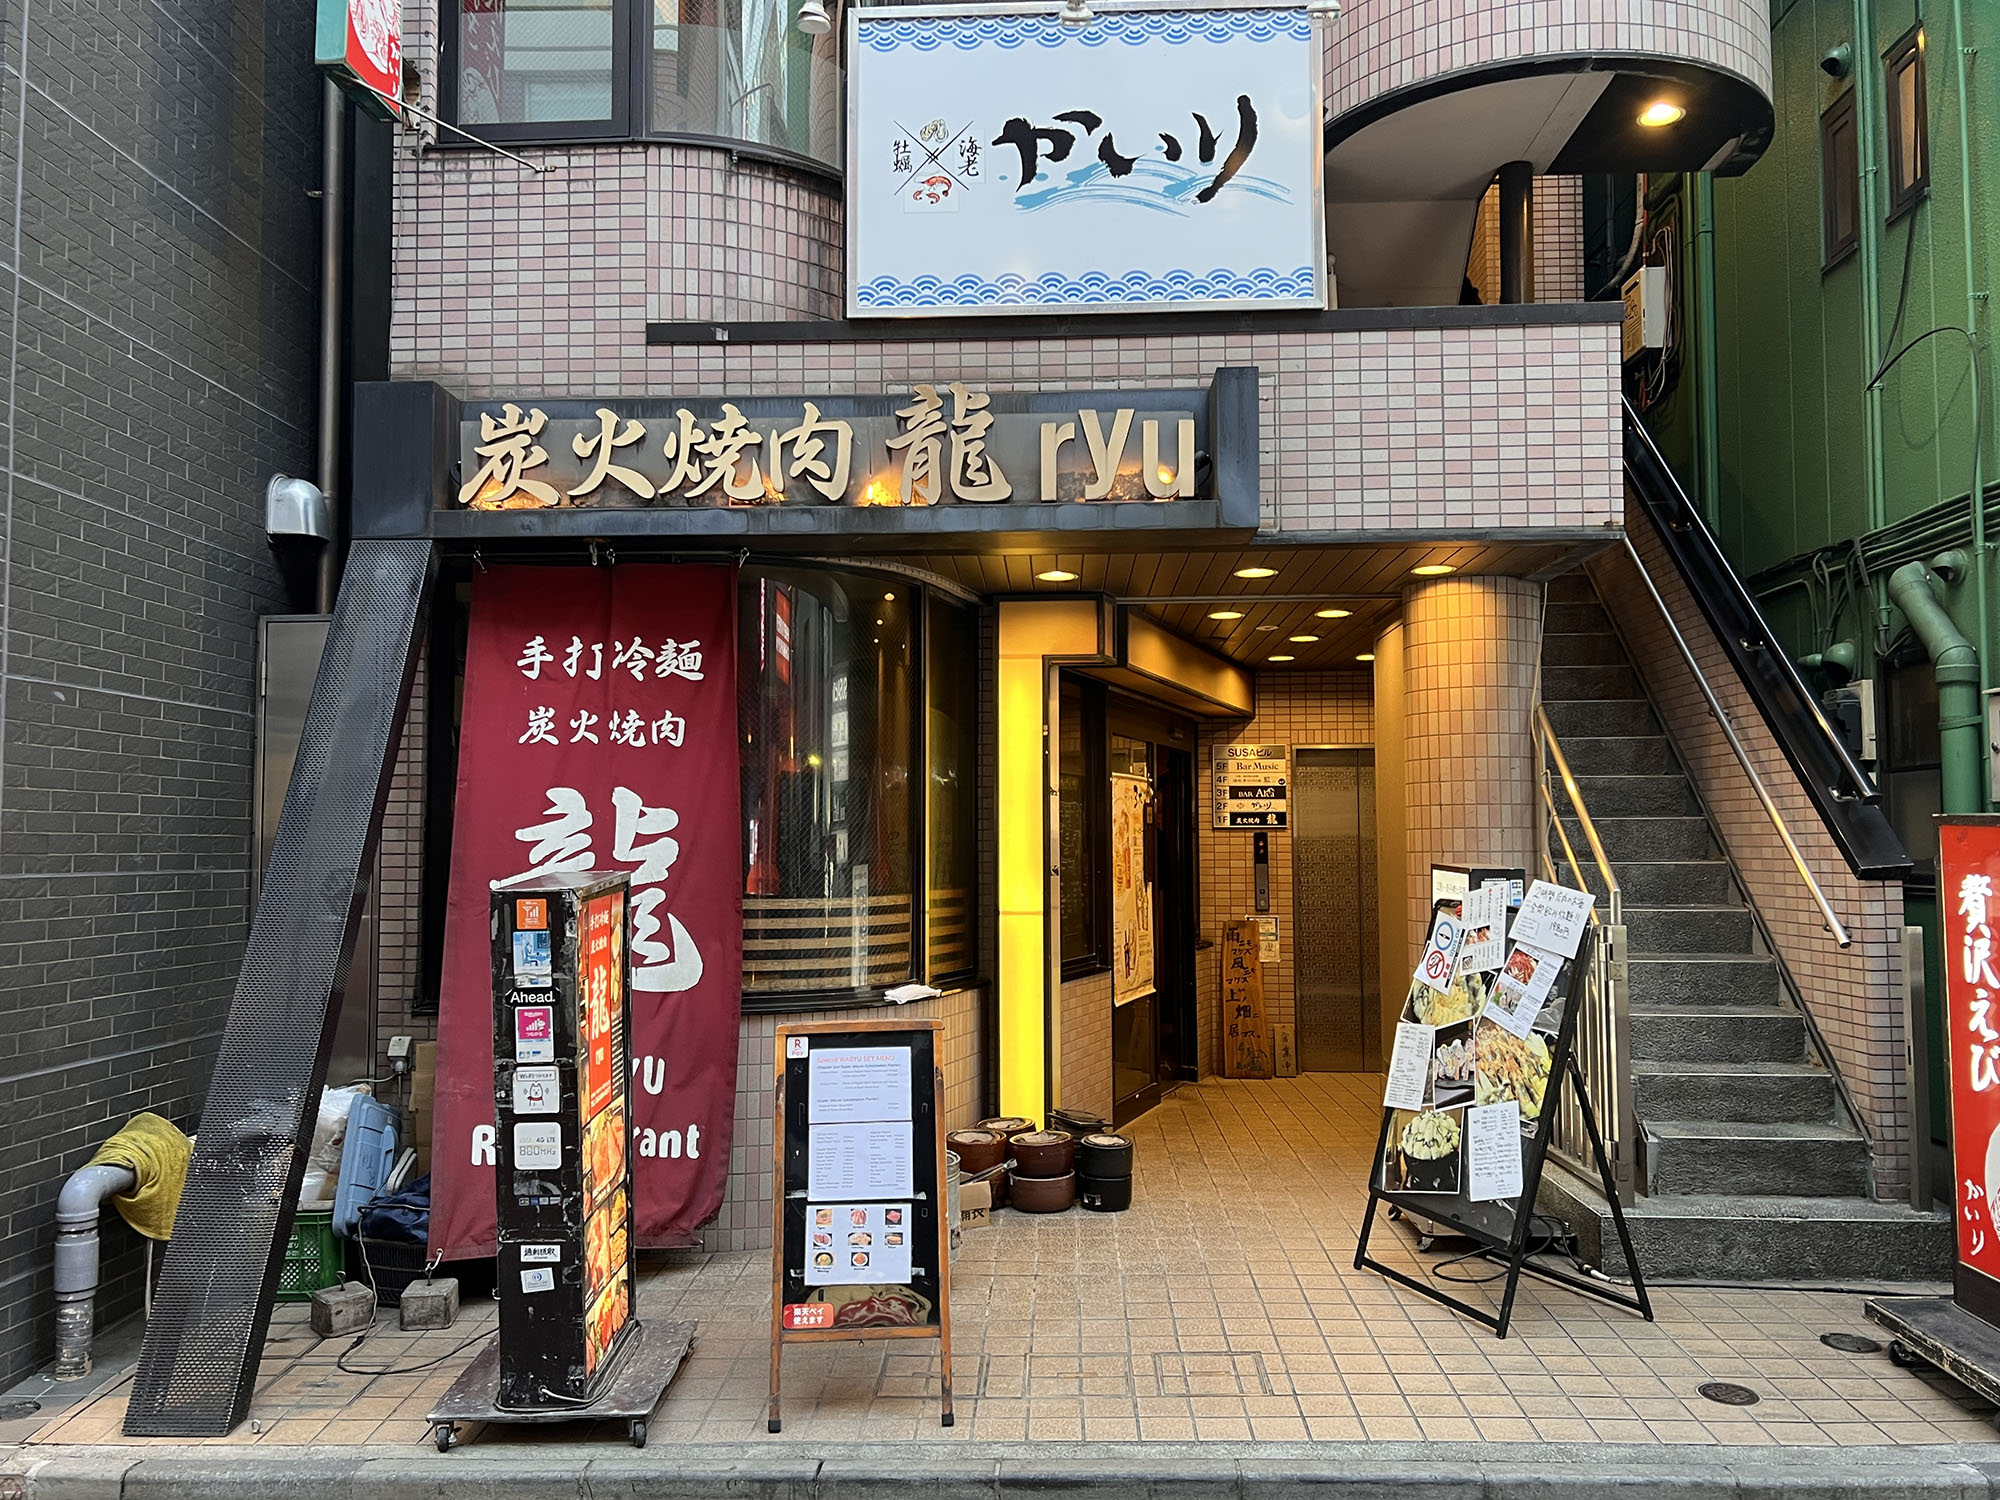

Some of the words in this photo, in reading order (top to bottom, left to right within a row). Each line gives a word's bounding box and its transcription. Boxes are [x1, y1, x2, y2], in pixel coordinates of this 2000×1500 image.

[893, 139, 912, 173] 牡蠣
[957, 136, 982, 176] 海老
[458, 402, 853, 505] 炭火焼肉
[885, 382, 1012, 505] 龍
[1040, 408, 1195, 500] ryu
[516, 635, 705, 682] 手打冷麺
[518, 705, 686, 748] 炭火焼肉
[1216, 762, 1228, 771] 5F
[1236, 762, 1251, 771] Bar
[1252, 762, 1279, 771] Music
[1216, 776, 1228, 784] 4F
[1216, 789, 1228, 797] 3F
[1216, 802, 1228, 810] 2F
[510, 990, 556, 1004] Ahead.
[1958, 874, 2000, 1092] 贅沢えび
[589, 964, 610, 1041] 龍
[794, 1038, 801, 1048] R
[1964, 1179, 1984, 1256] かいり
